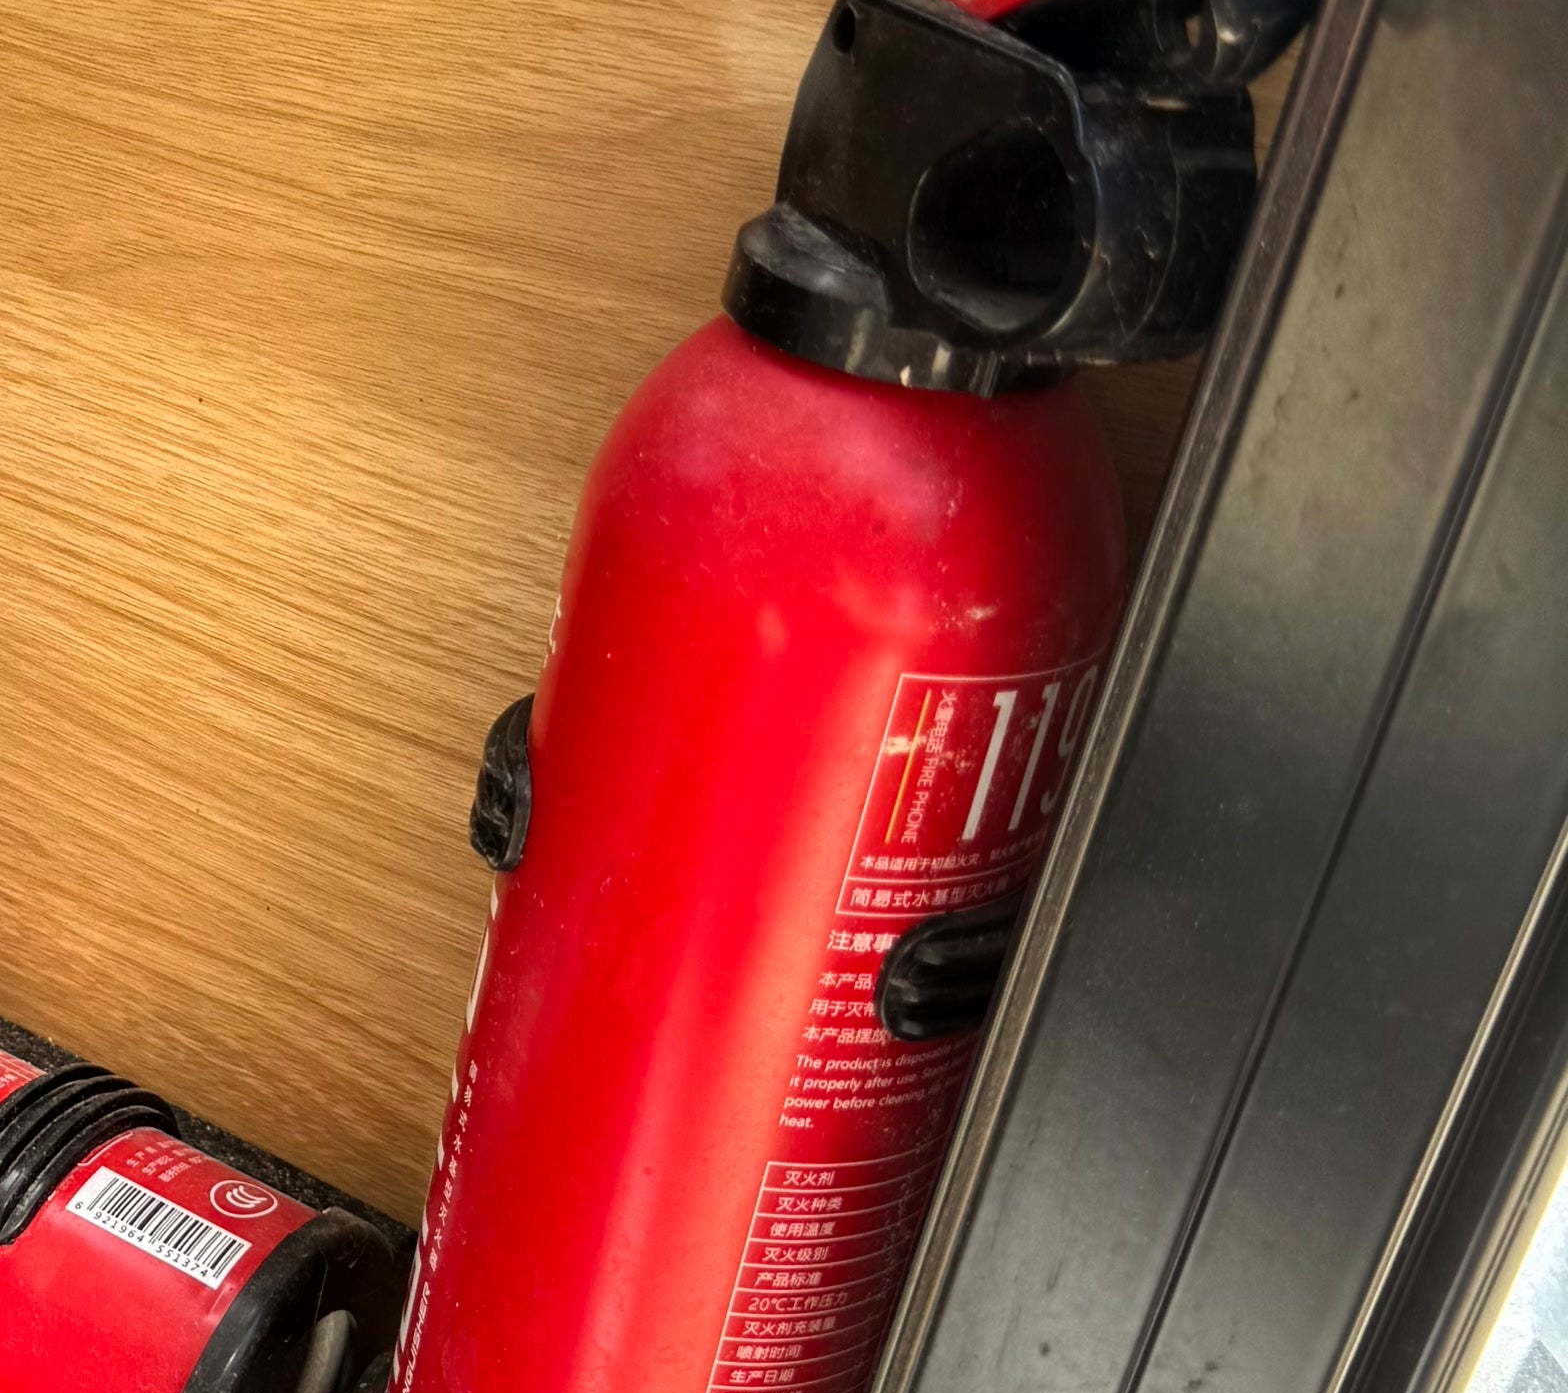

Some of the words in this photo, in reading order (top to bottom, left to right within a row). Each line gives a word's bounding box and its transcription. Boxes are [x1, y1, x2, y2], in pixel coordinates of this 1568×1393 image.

[917, 758, 939, 787] FIRE
[901, 791, 929, 844] PHONE
[826, 929, 900, 953] 注意事
[818, 972, 875, 991] 本产品
[802, 1026, 892, 1046] 本产品摆放
[796, 1054, 821, 1069] The
[825, 1056, 879, 1072] product
[789, 1074, 800, 1087] it
[803, 1077, 861, 1092] properly
[864, 1075, 893, 1090] after
[784, 1096, 830, 1112] power
[833, 1096, 875, 1110] before
[878, 1088, 926, 1107] cleaning
[779, 1113, 814, 1129] heat.
[783, 1170, 836, 1187] 灭火剂
[775, 1196, 843, 1212] 灭火种类
[770, 1221, 835, 1238] 使用温度
[74, 1201, 84, 1210] 6
[93, 1212, 145, 1243] 921964
[156, 1245, 209, 1278] 551374
[762, 1246, 829, 1262] 灭火级别
[754, 1271, 823, 1288] 产品标准
[735, 1343, 802, 1360] 喷射时间
[729, 1369, 795, 1384] 生产日期
